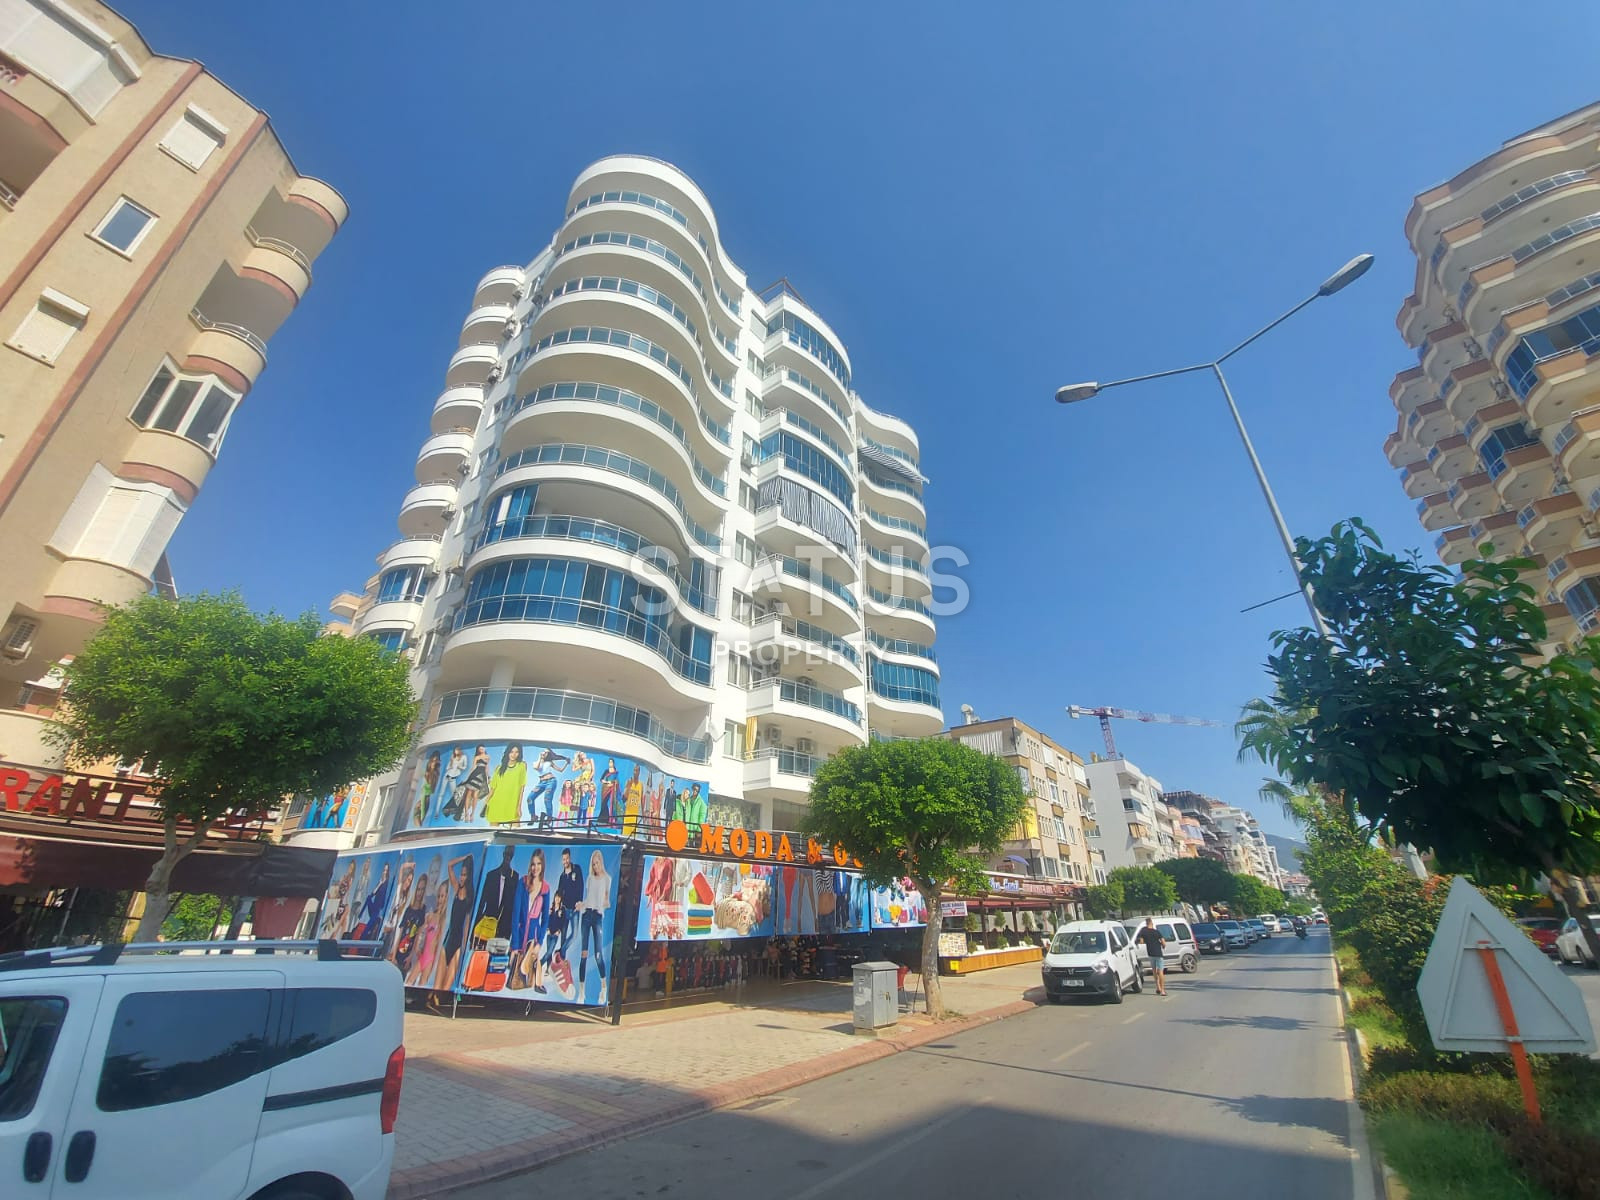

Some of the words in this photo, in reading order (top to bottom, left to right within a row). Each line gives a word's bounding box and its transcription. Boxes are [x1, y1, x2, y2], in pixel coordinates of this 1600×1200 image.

[0, 767, 148, 823] RANT
[345, 783, 367, 828] MODA
[699, 823, 795, 862] MODA
